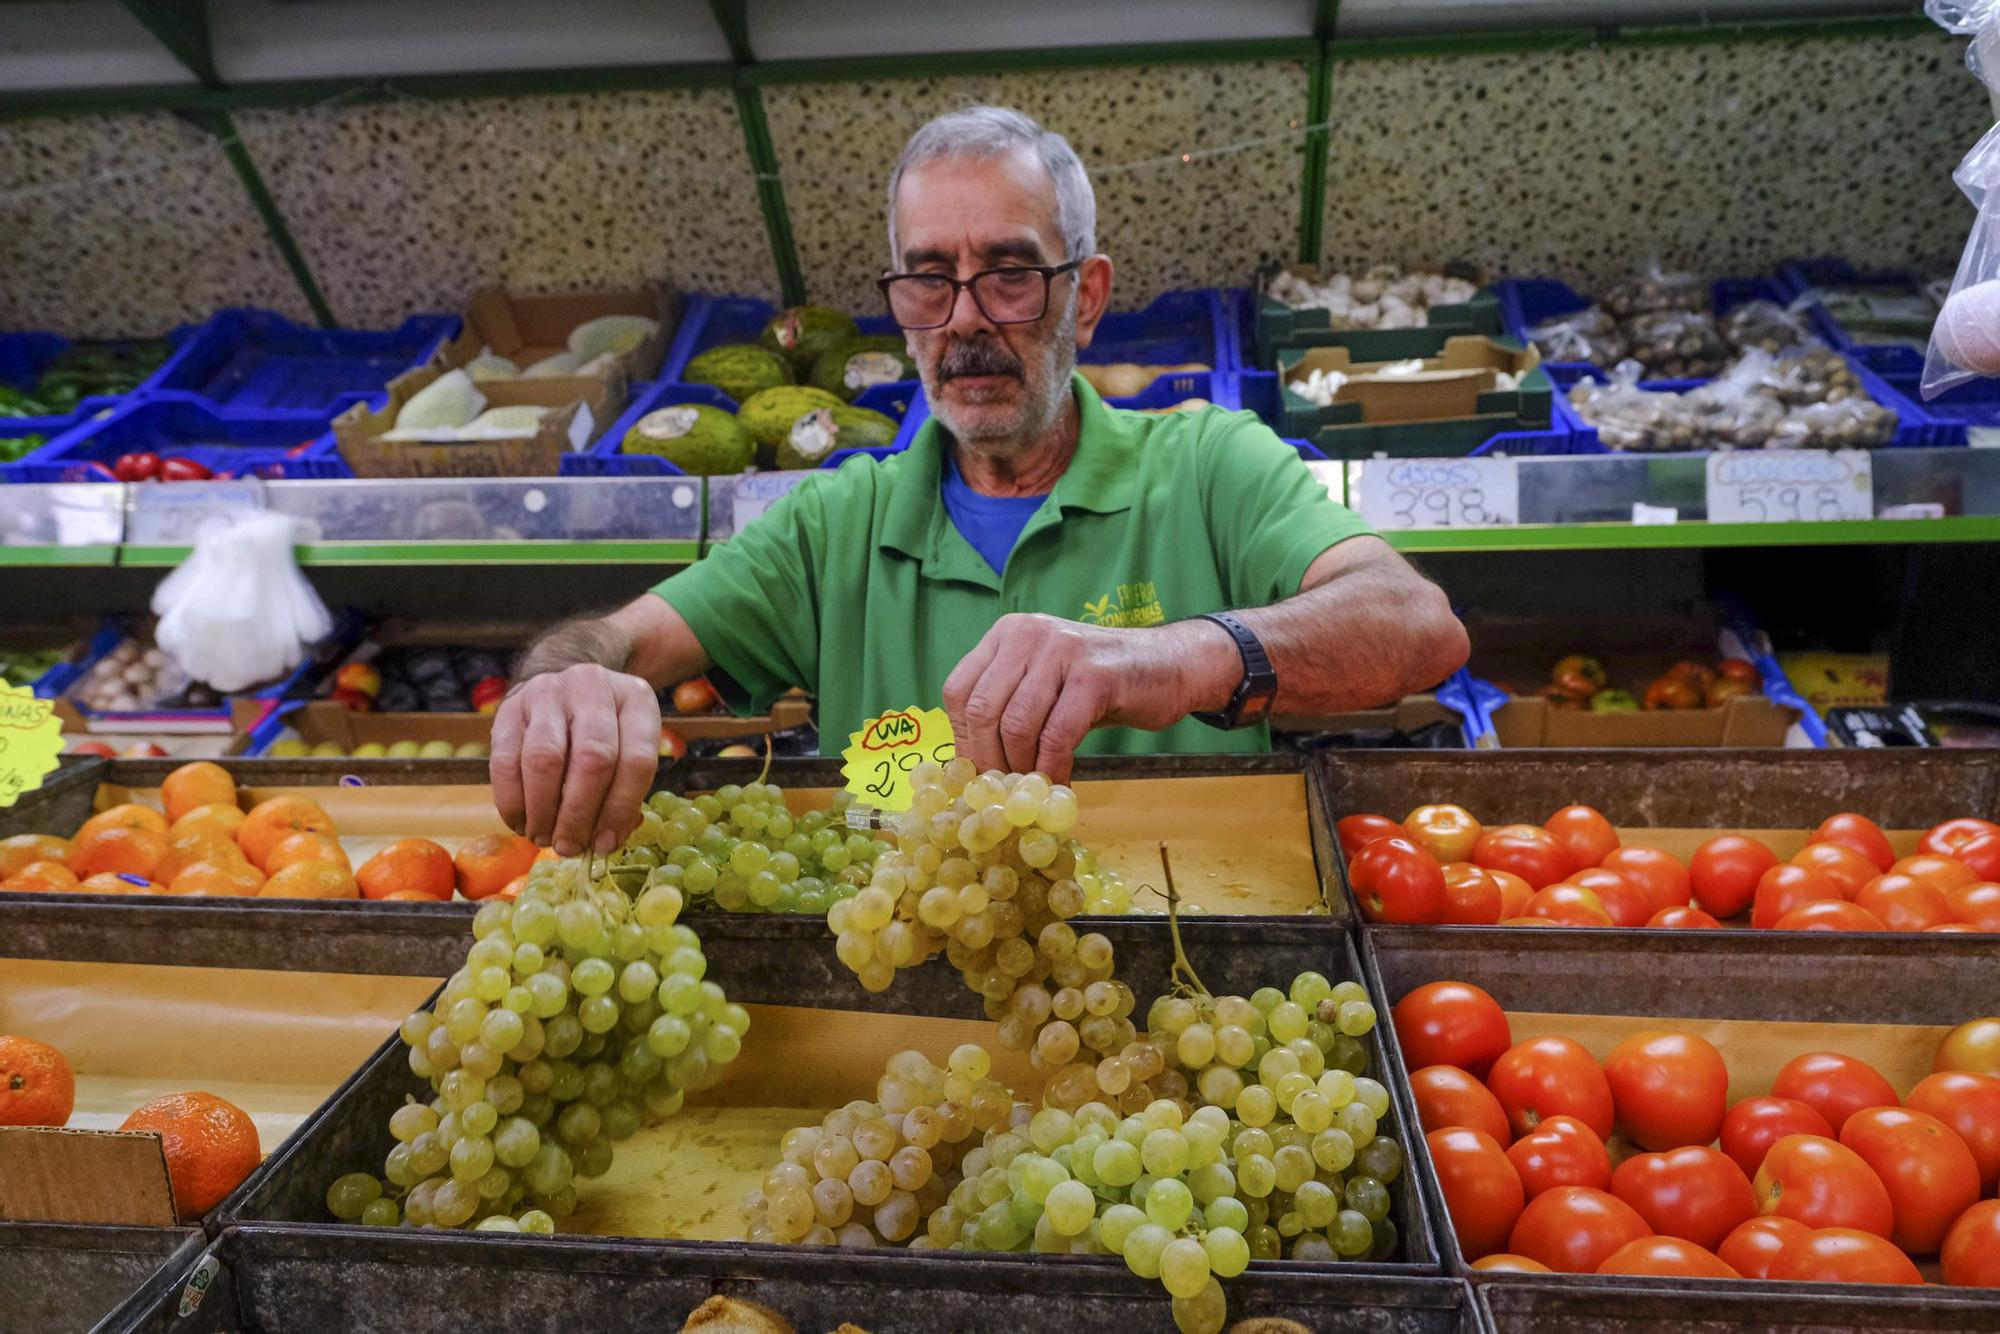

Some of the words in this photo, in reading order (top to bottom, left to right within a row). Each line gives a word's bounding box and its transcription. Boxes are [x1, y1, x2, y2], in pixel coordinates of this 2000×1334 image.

[1390, 488, 1485, 526] 3'98
[1739, 486, 1842, 522] 5'98
[876, 718, 915, 740] UVA
